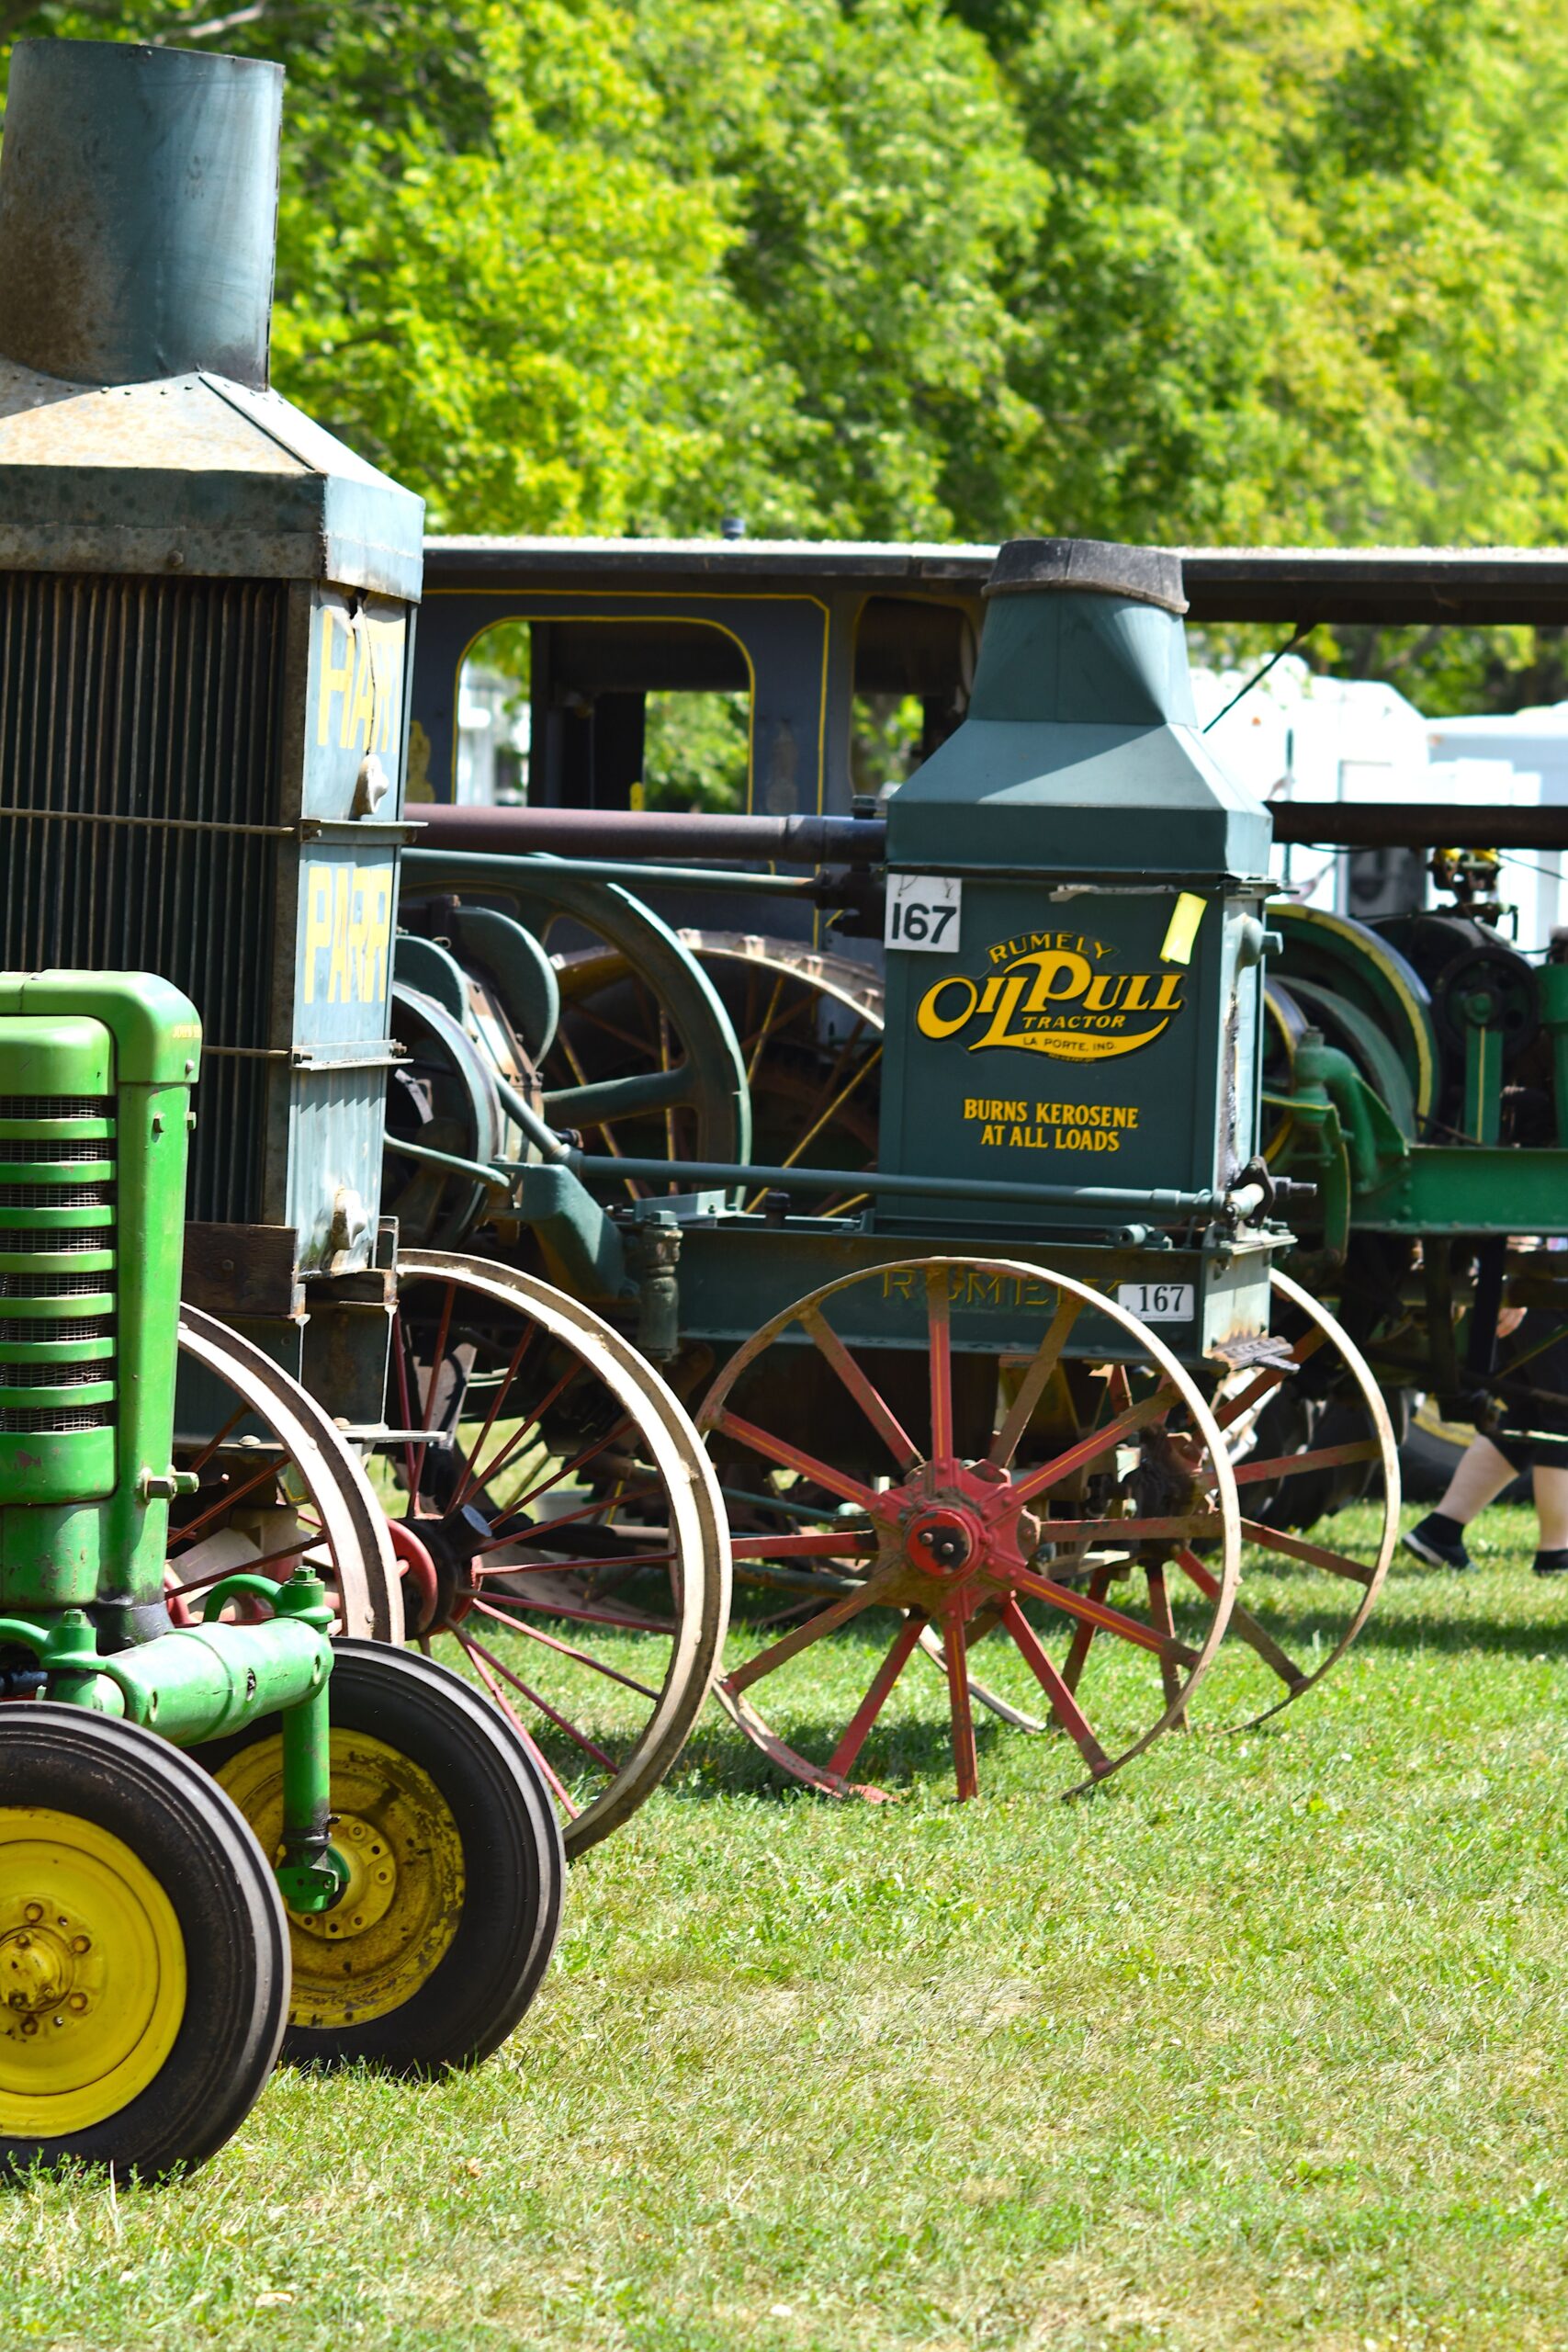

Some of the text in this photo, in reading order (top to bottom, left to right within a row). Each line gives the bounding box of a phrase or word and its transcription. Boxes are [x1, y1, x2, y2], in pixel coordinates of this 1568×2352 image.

[304, 866, 392, 1004] PARR
[892, 902, 957, 944] 167
[988, 933, 1112, 964] RUMELY
[1021, 1014, 1127, 1030] TRACTOR
[1022, 1036, 1037, 1046] LA
[964, 1099, 1139, 1129] BURNS KEROSENE
[981, 1125, 1121, 1152] AT ALL LOADS
[1139, 1285, 1185, 1312] 167
